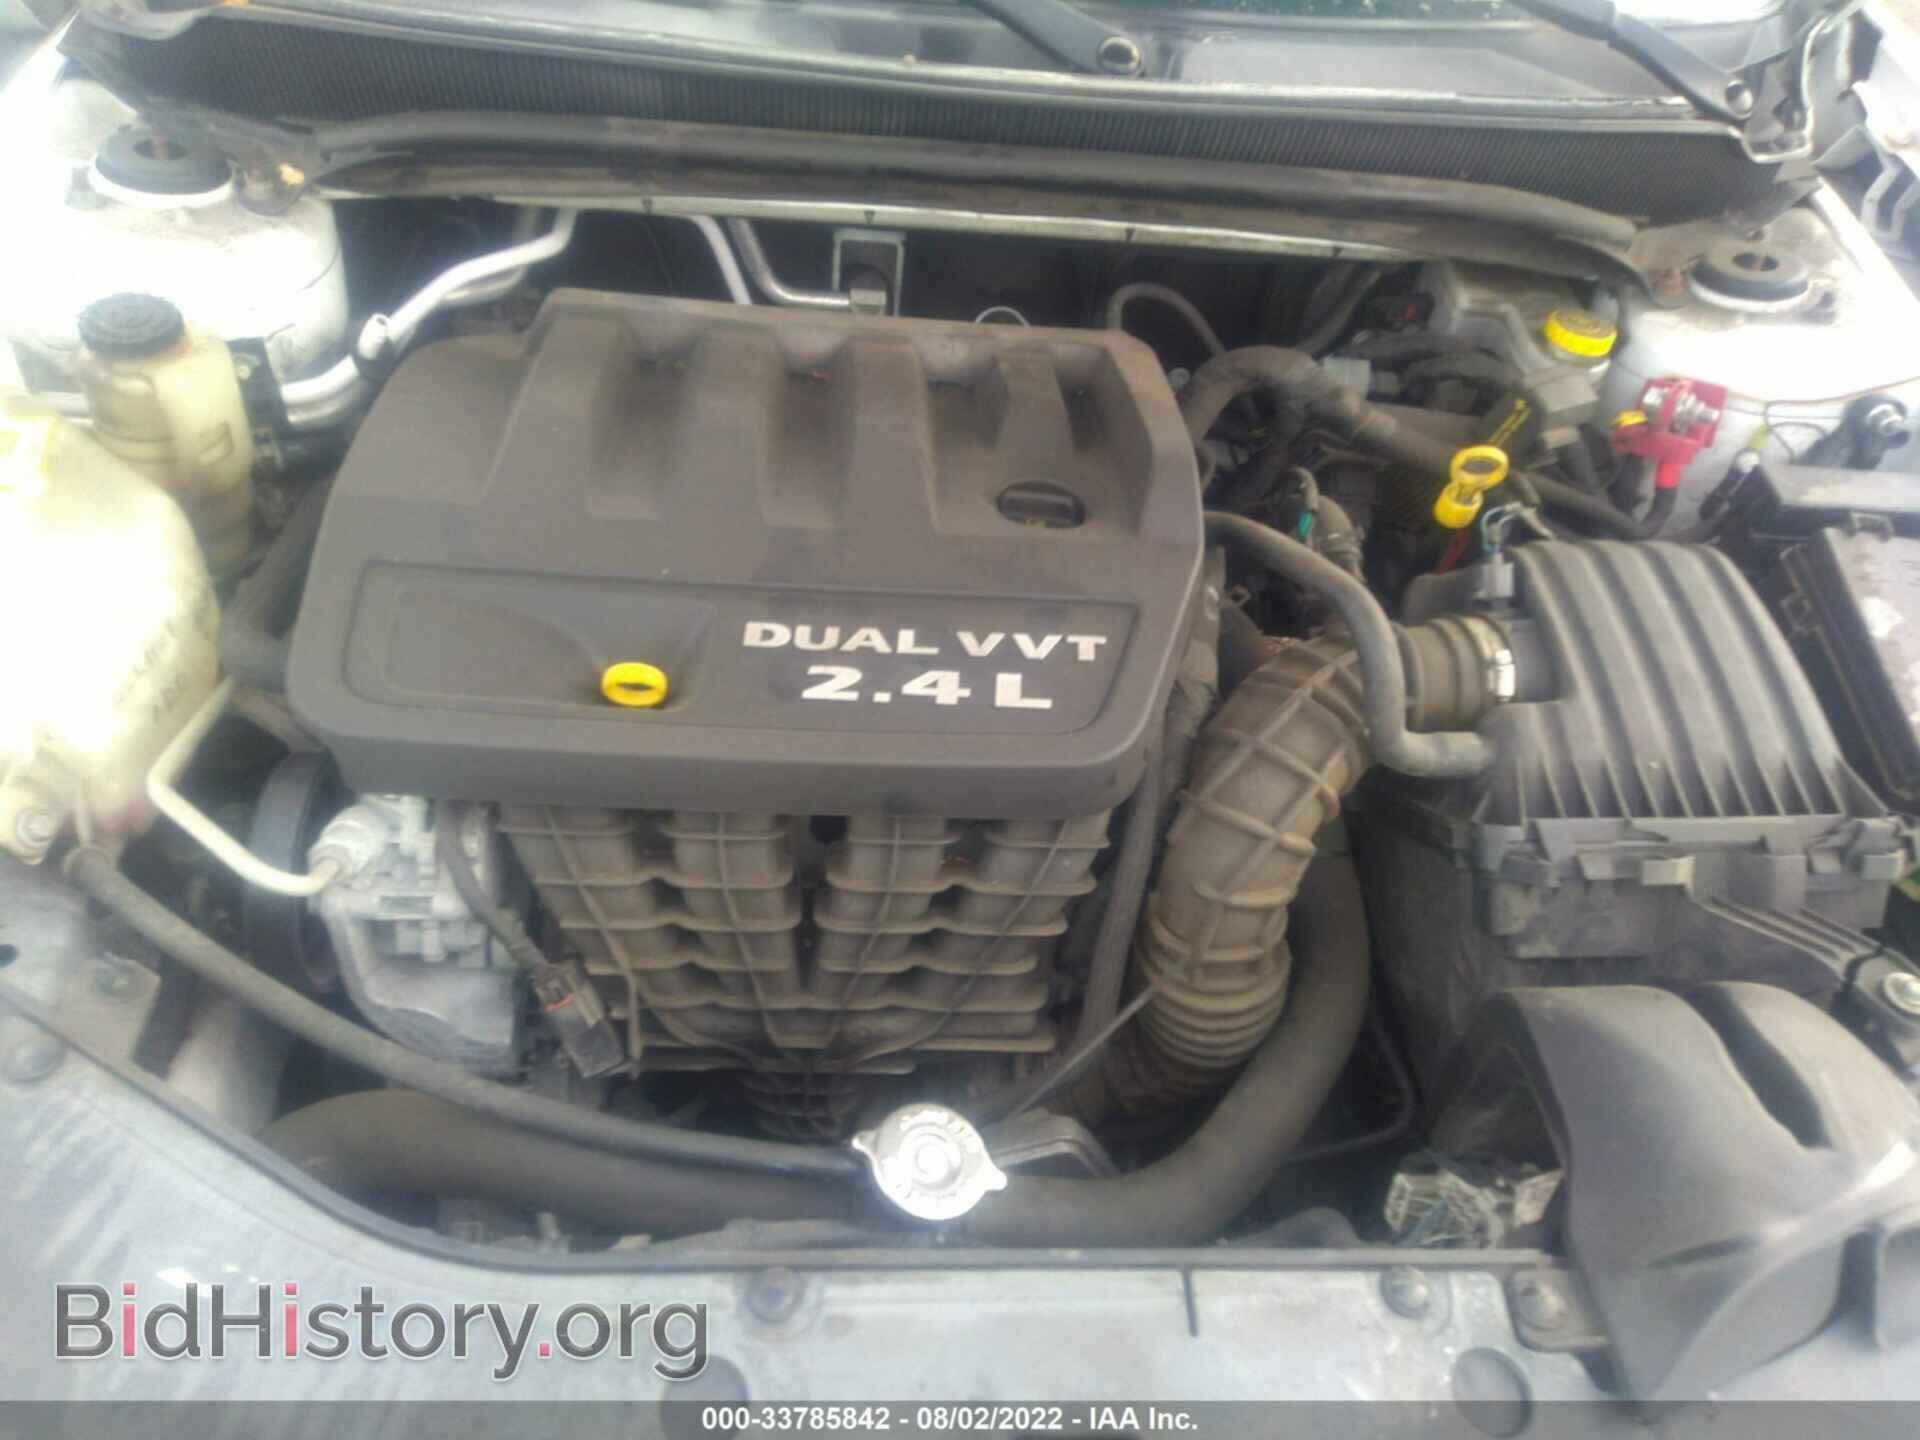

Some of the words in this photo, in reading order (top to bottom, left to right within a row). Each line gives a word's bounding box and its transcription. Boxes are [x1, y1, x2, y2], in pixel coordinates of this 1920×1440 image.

[742, 621, 939, 655] DUAL
[956, 630, 1107, 661] VVT
[801, 664, 971, 706] 2.4
[994, 672, 1053, 709] L
